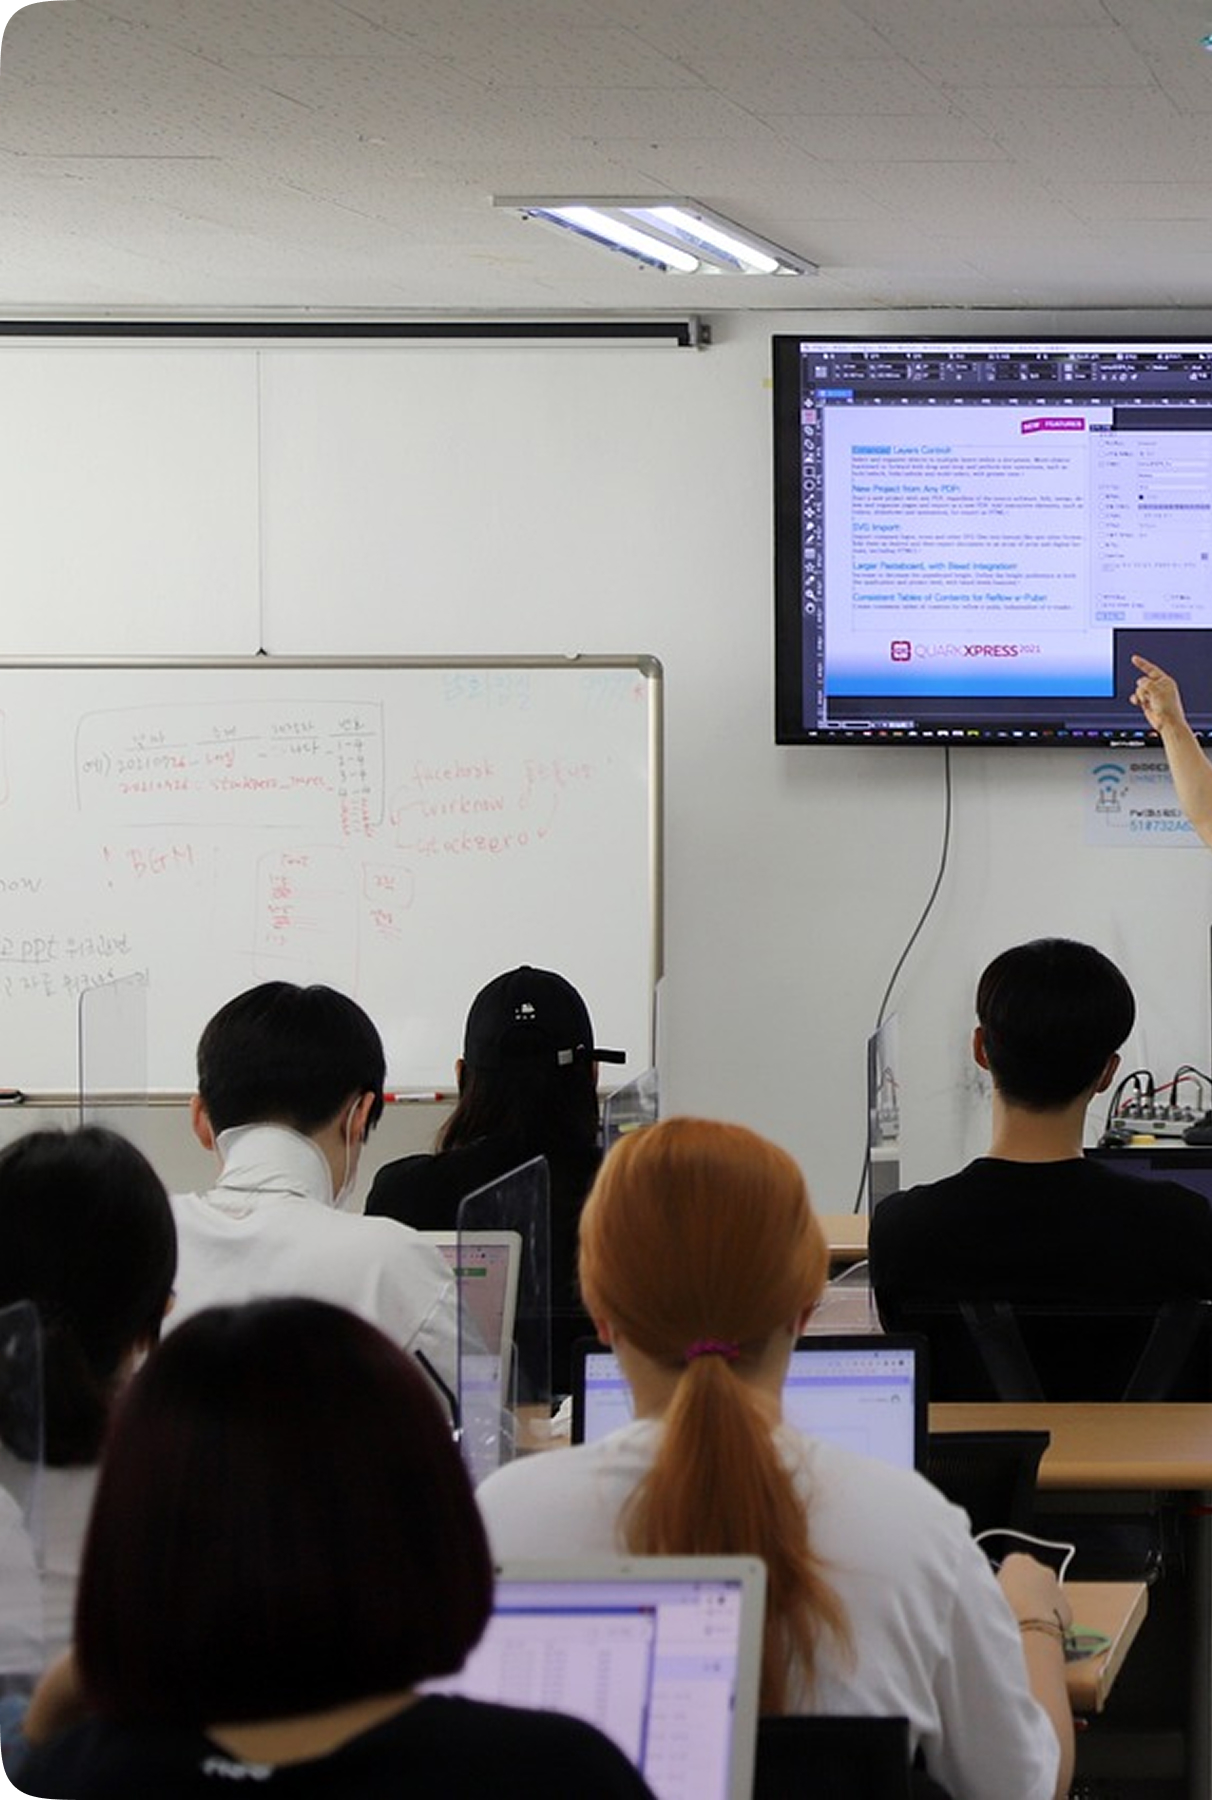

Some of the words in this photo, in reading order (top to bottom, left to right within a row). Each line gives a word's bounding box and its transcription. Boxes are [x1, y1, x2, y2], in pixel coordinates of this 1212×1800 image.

[1023, 420, 1040, 431] NEW
[1044, 420, 1082, 428] FEATURES
[893, 446, 919, 455] Layers
[873, 484, 900, 493] Project
[903, 484, 921, 492] from
[924, 485, 938, 493] Any
[852, 523, 870, 531] SVG
[852, 562, 877, 571] Larger
[929, 562, 946, 570] with
[897, 592, 922, 601] Tables
[924, 593, 932, 601] of
[934, 592, 970, 602] Contents
[972, 593, 983, 601] for
[1019, 643, 1041, 654] 2021
